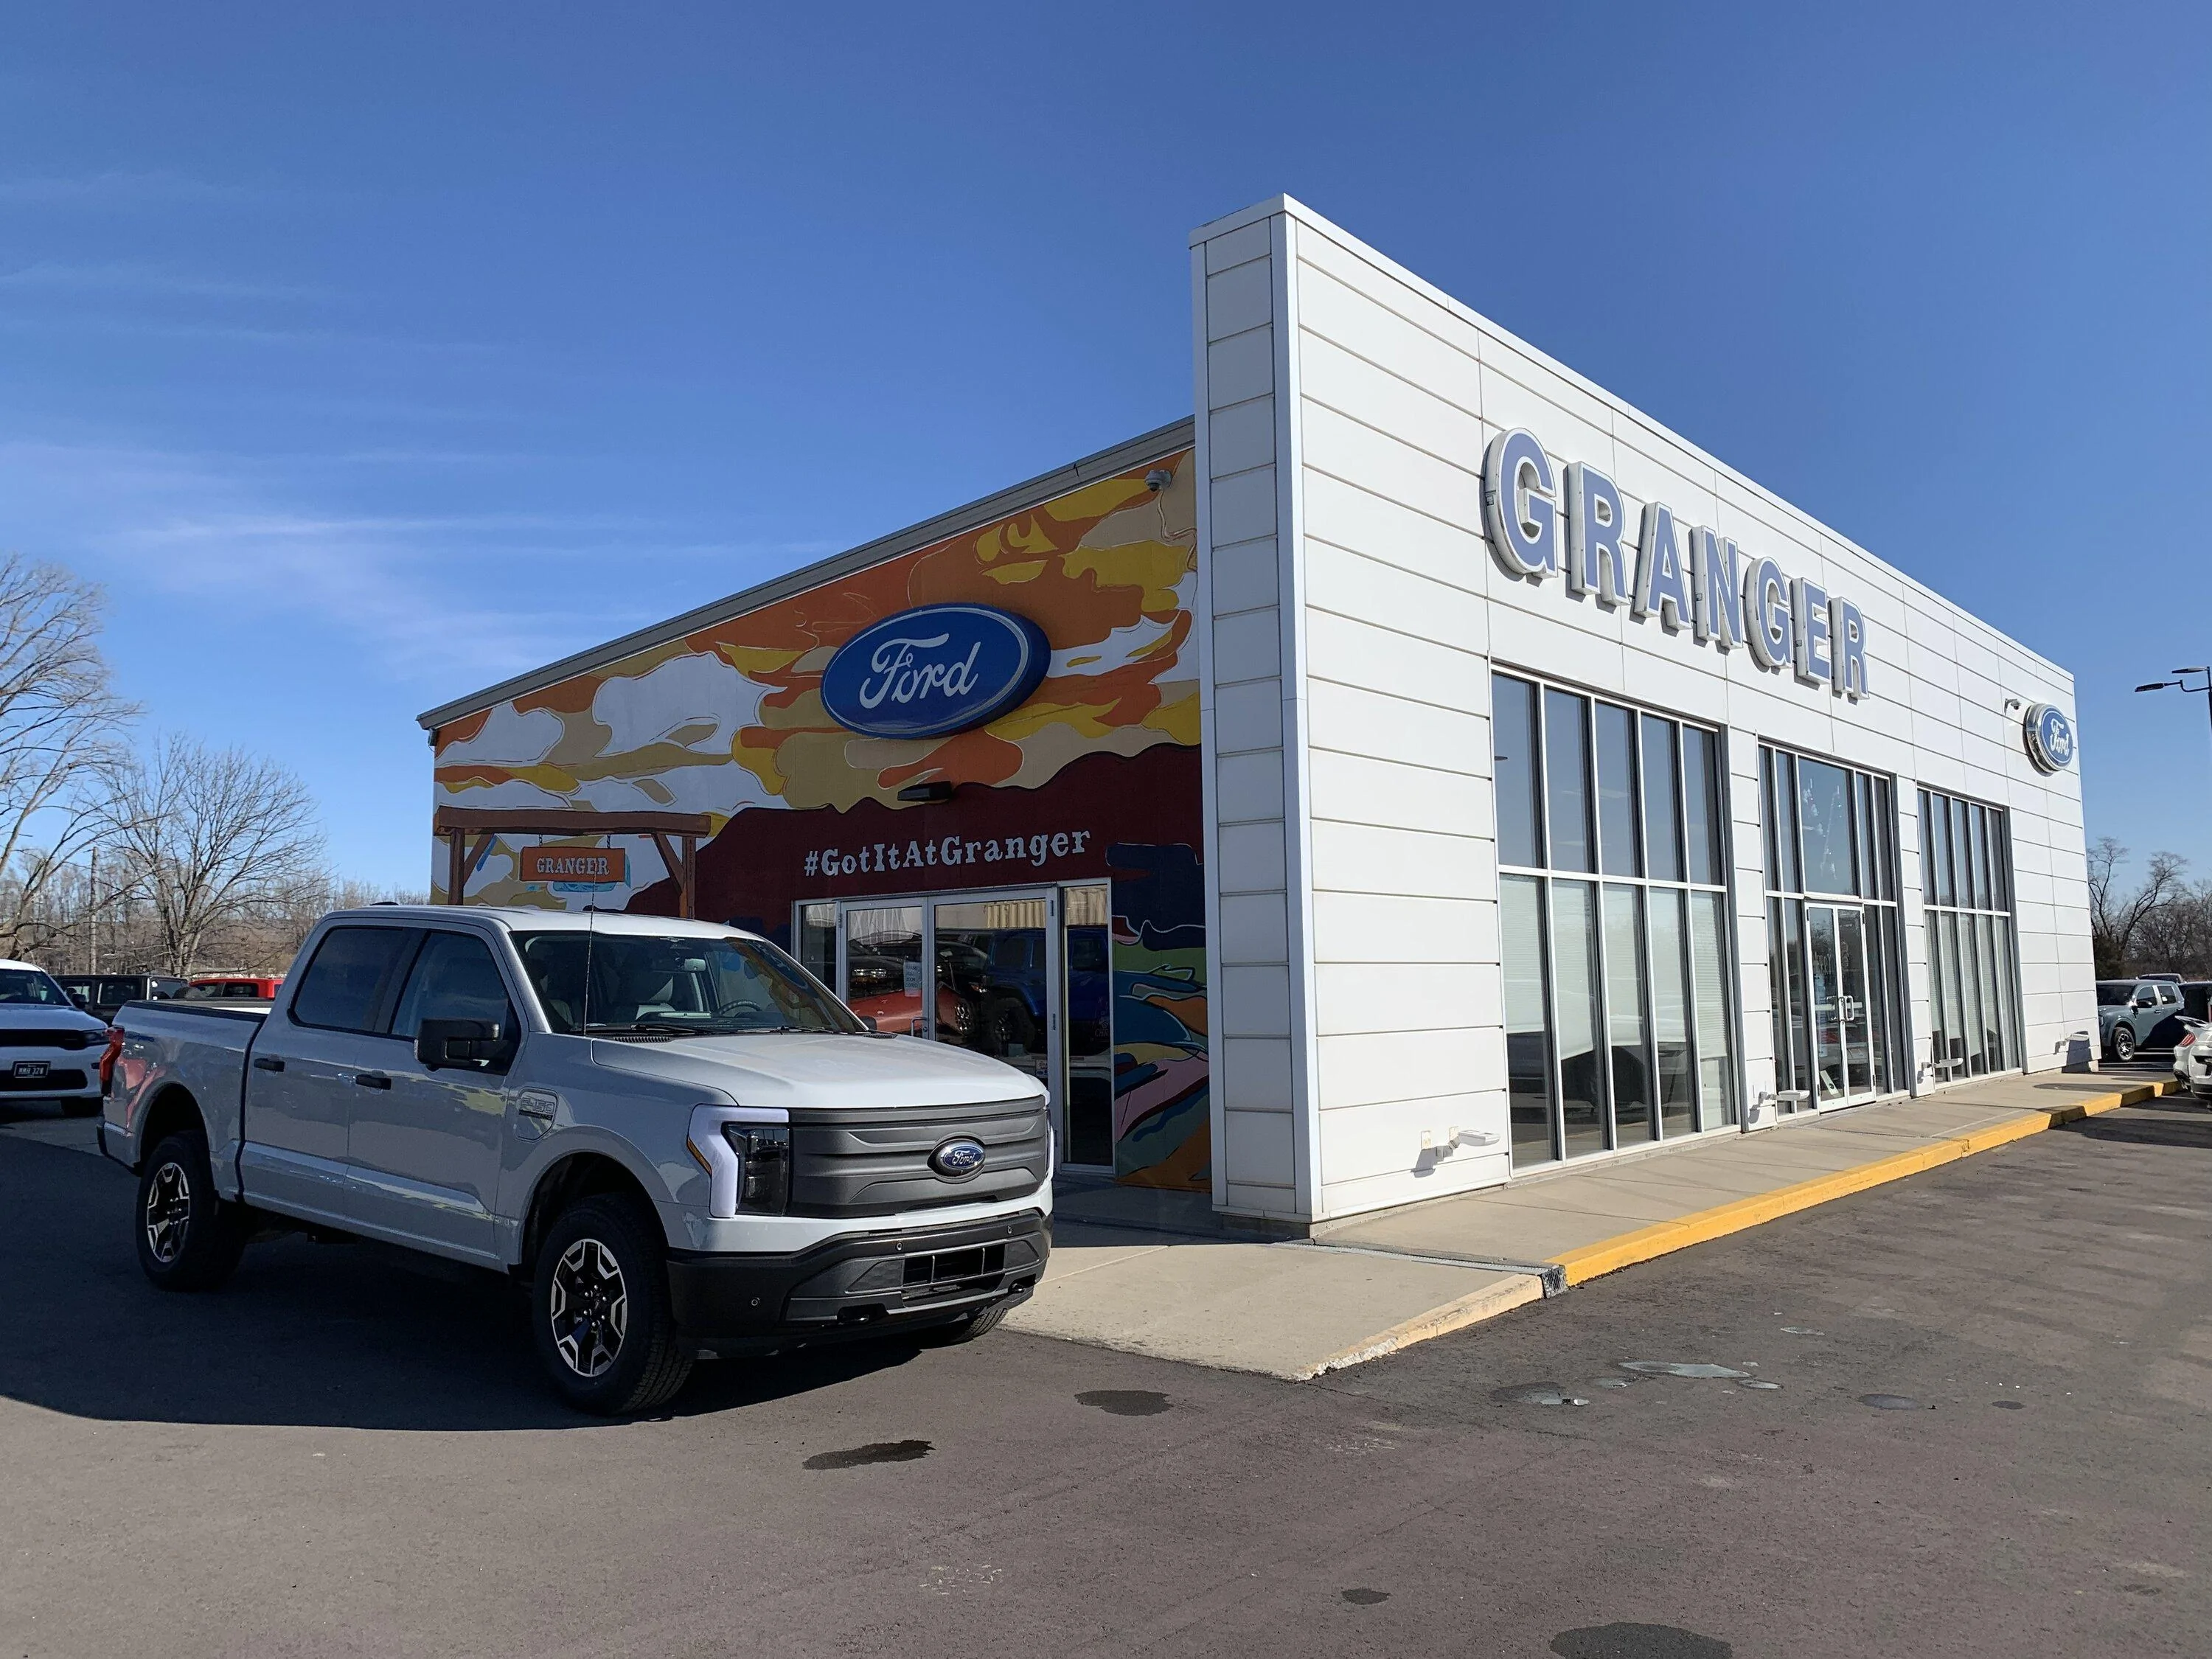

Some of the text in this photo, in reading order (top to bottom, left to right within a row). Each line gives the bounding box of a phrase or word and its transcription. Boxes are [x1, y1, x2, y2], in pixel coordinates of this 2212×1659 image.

[1484, 428, 1869, 700] GRANGER
[859, 633, 981, 709] Ford
[2050, 717, 2070, 757] Ford
[536, 856, 610, 875] GRANGER
[804, 830, 1091, 876] #GotItAtGranger
[952, 1150, 975, 1165] Ford
